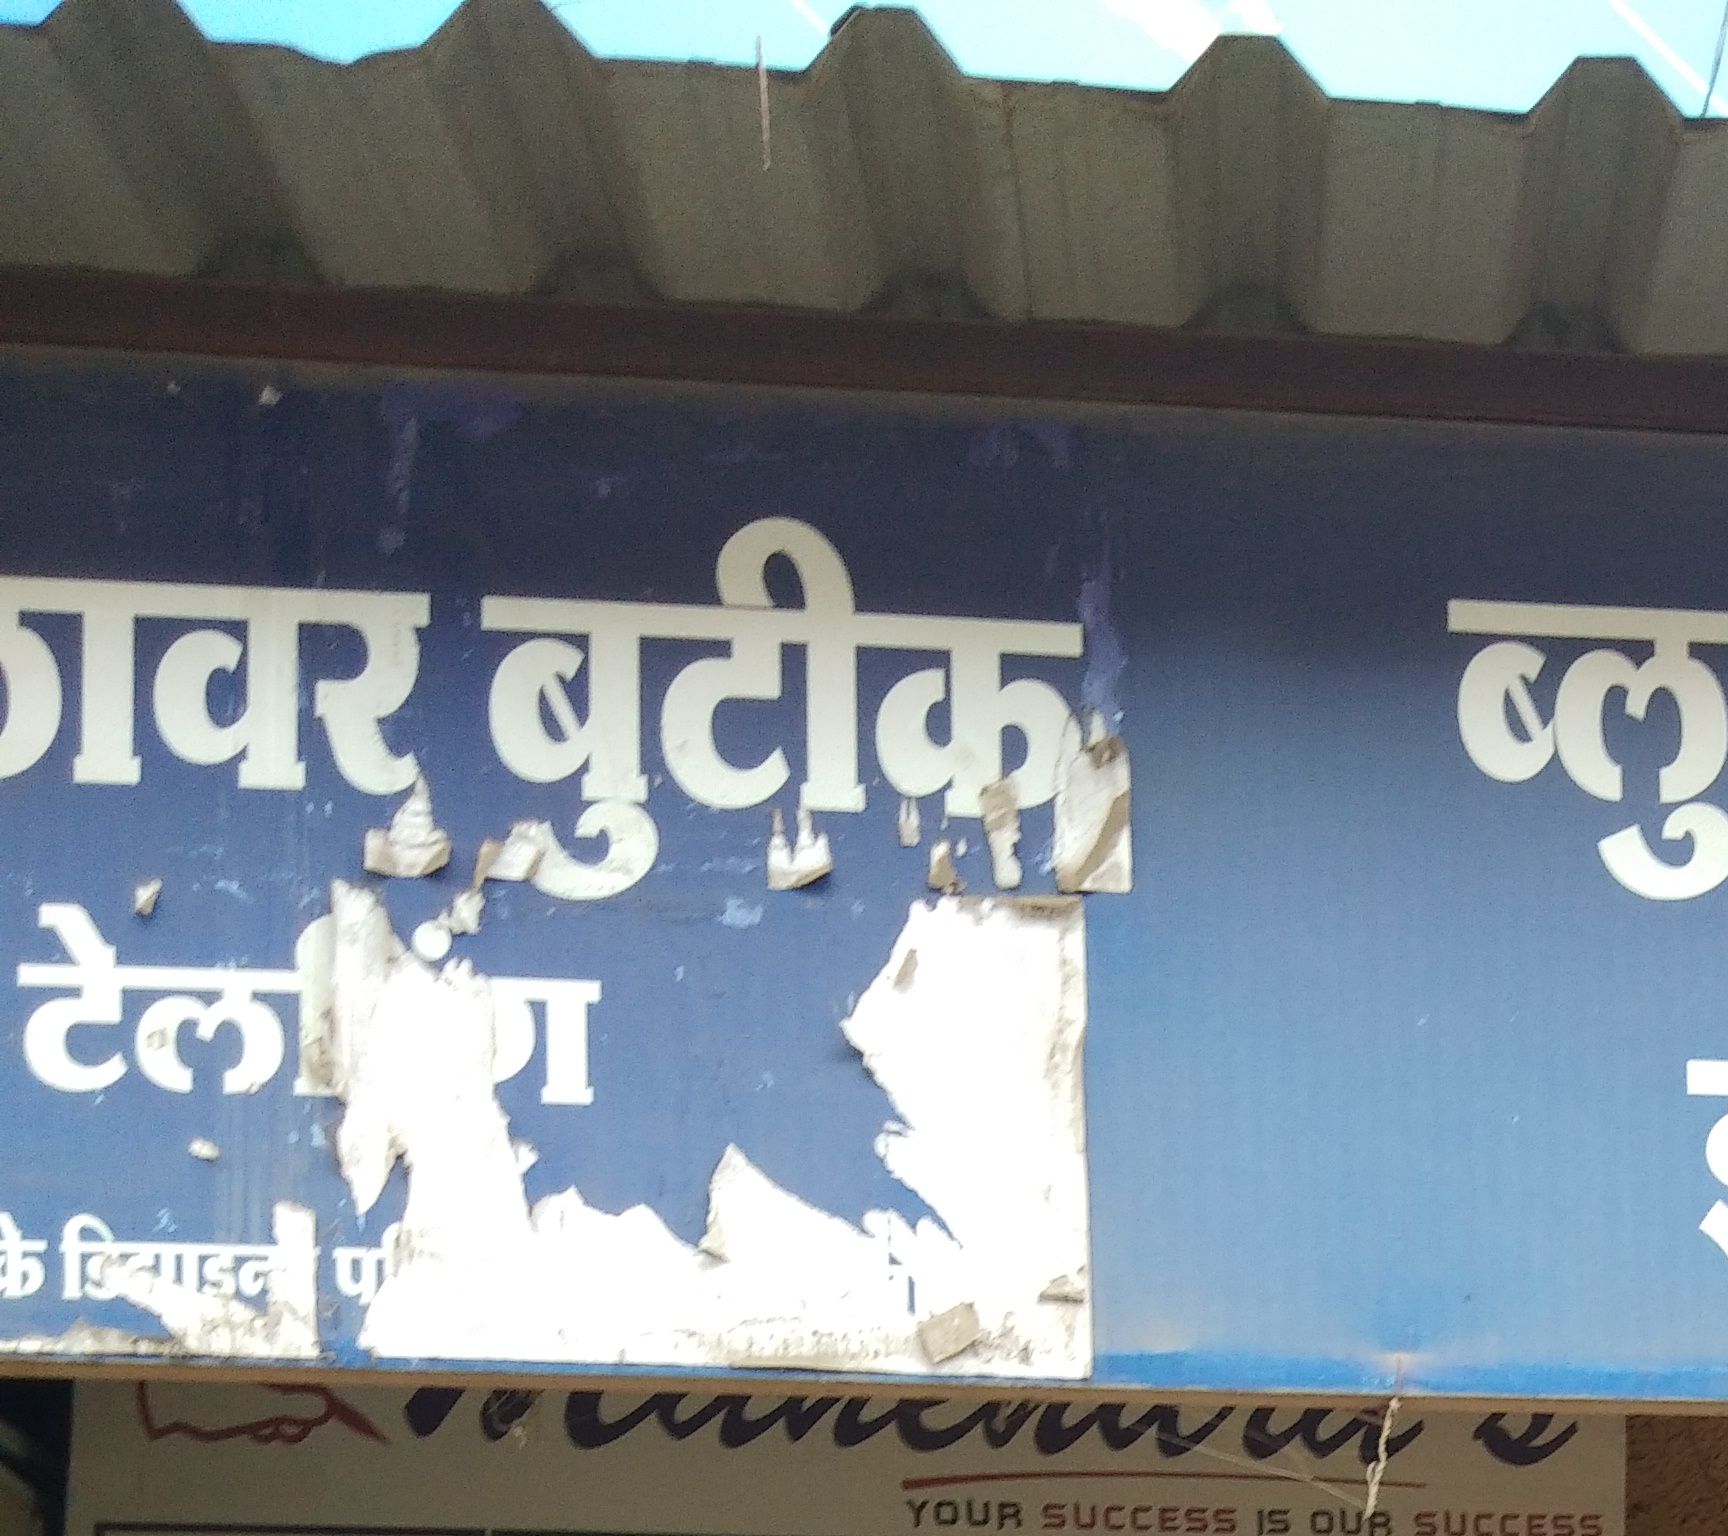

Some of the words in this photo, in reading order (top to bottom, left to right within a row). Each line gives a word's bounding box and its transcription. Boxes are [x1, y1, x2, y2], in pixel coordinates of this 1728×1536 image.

[481, 516, 1087, 901] बुटीक
[905, 1498, 1024, 1531] YOUR
[1040, 1503, 1238, 1536] SUCCESS
[1255, 1508, 1291, 1536] IS
